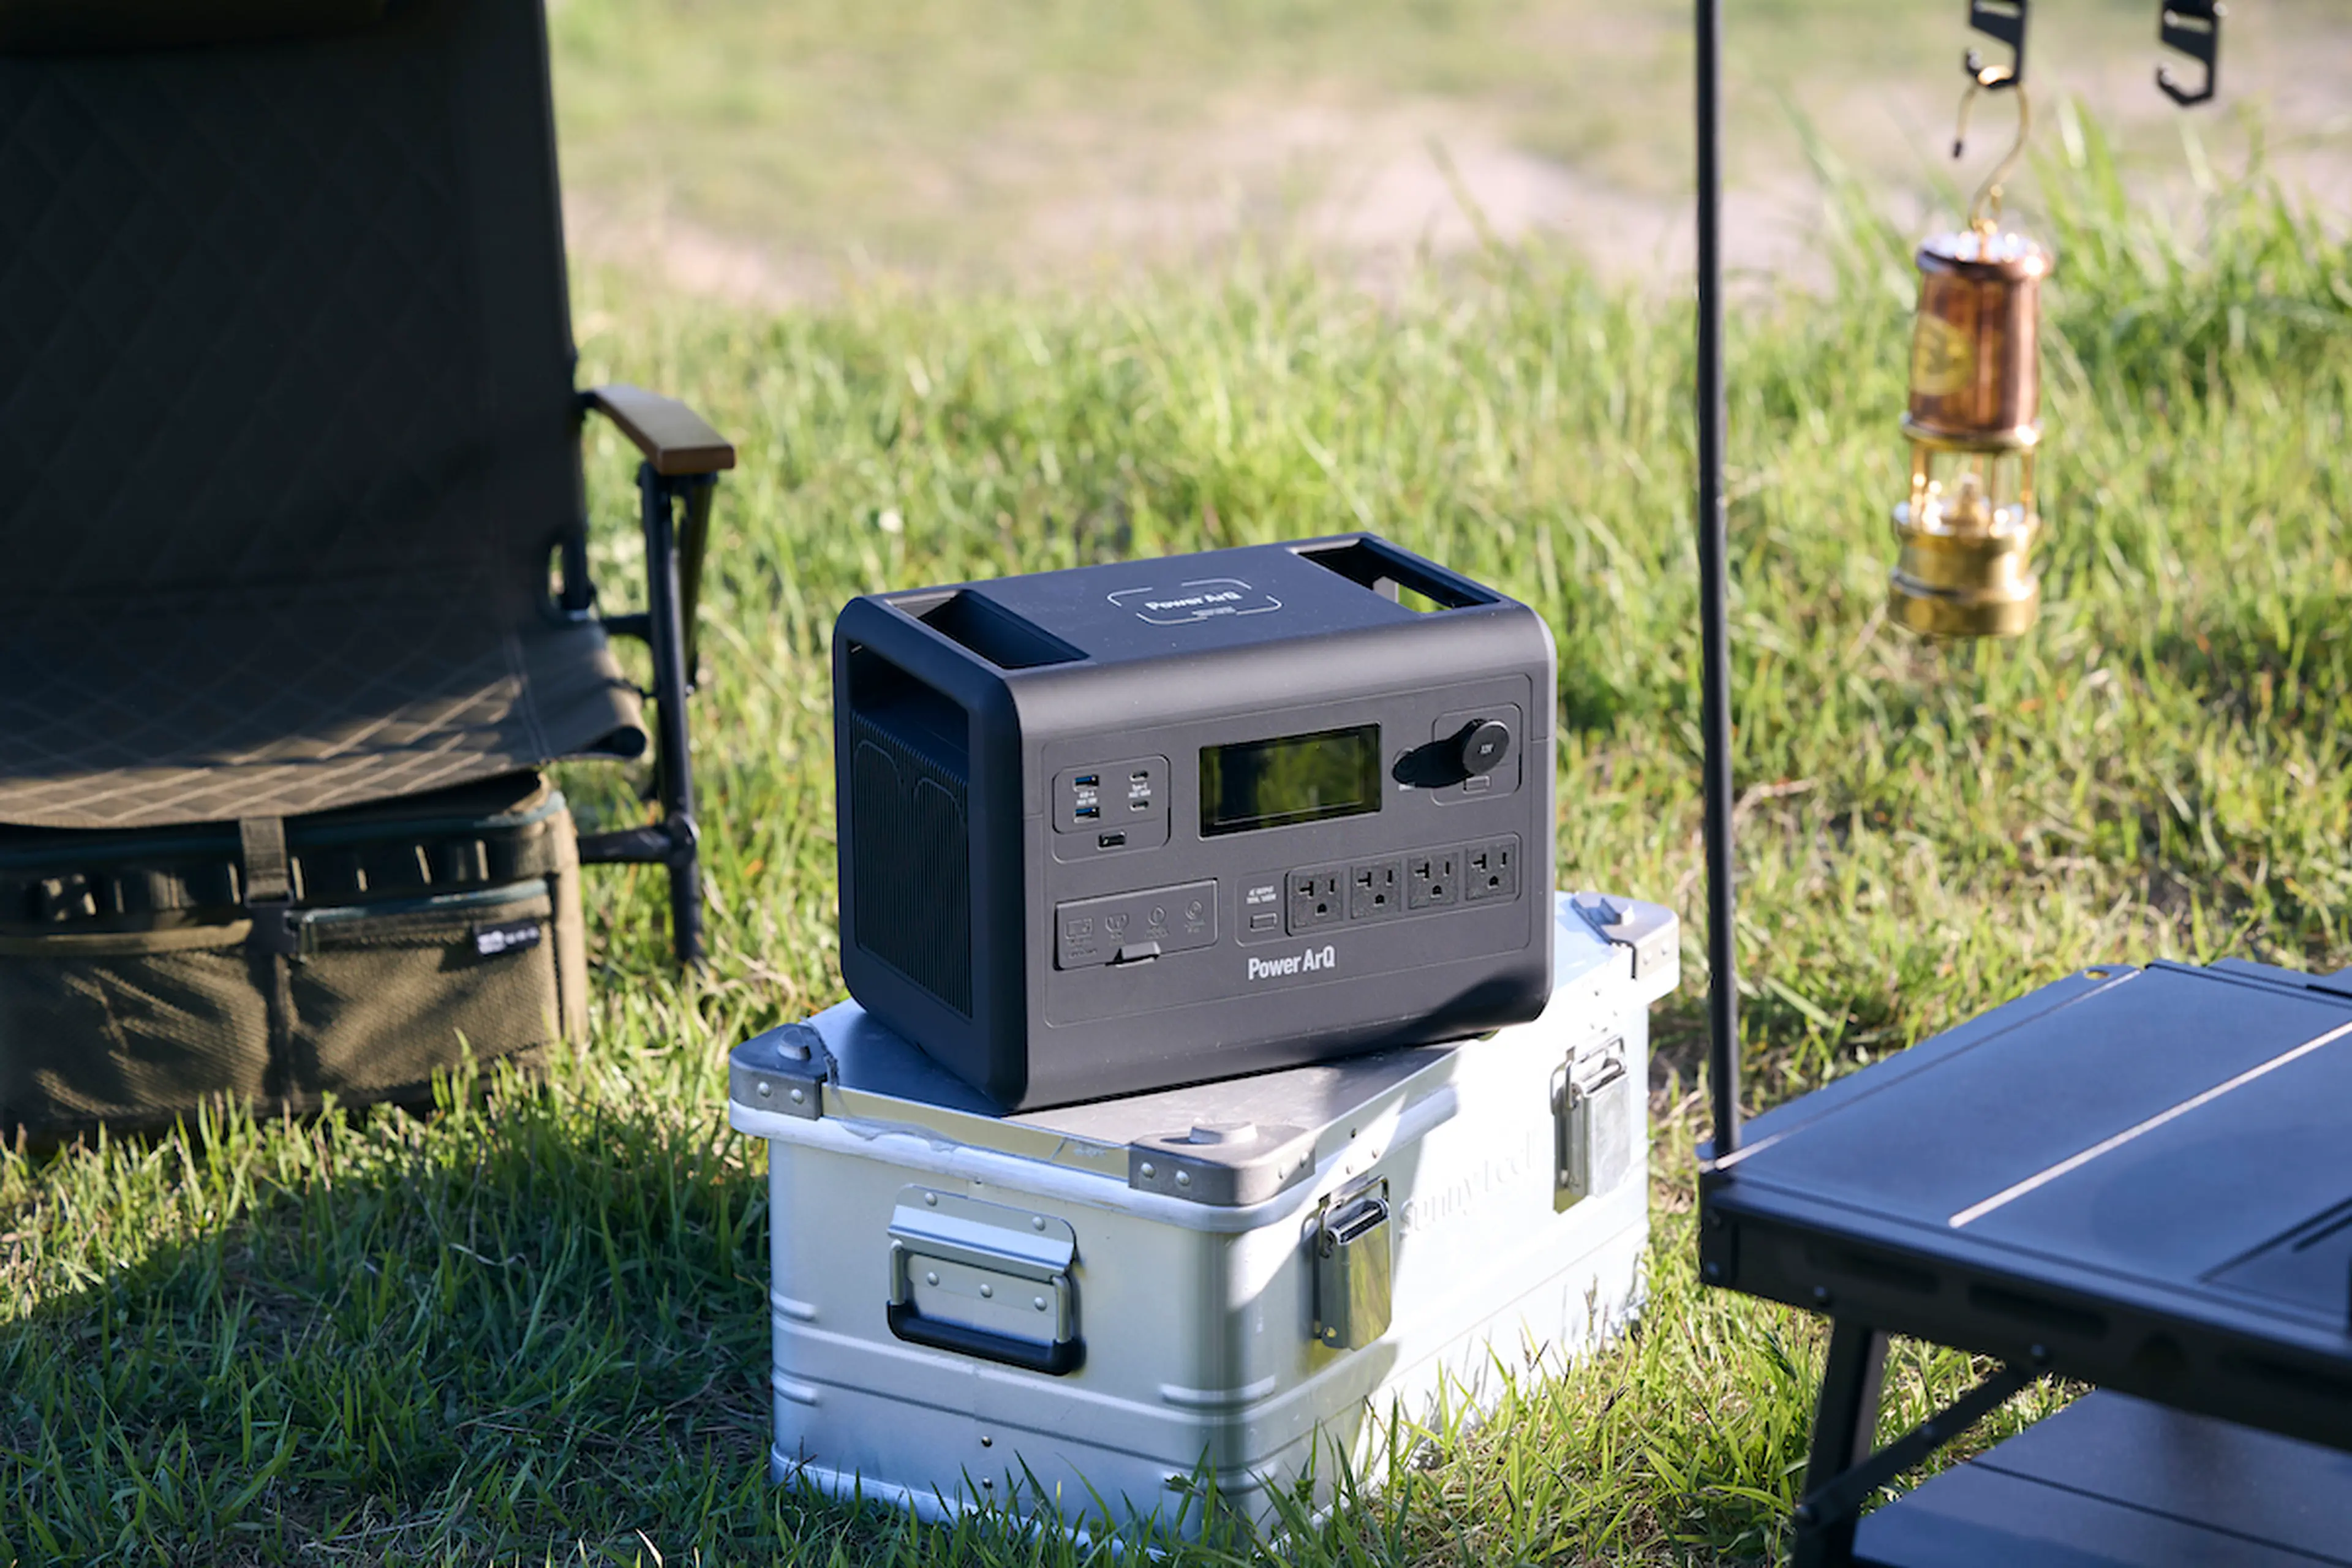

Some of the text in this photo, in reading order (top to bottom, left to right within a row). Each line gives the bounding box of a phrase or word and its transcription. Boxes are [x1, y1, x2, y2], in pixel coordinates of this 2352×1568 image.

[1144, 592, 1243, 611] Power ArQ
[1248, 945, 1335, 981] Power ArQ
